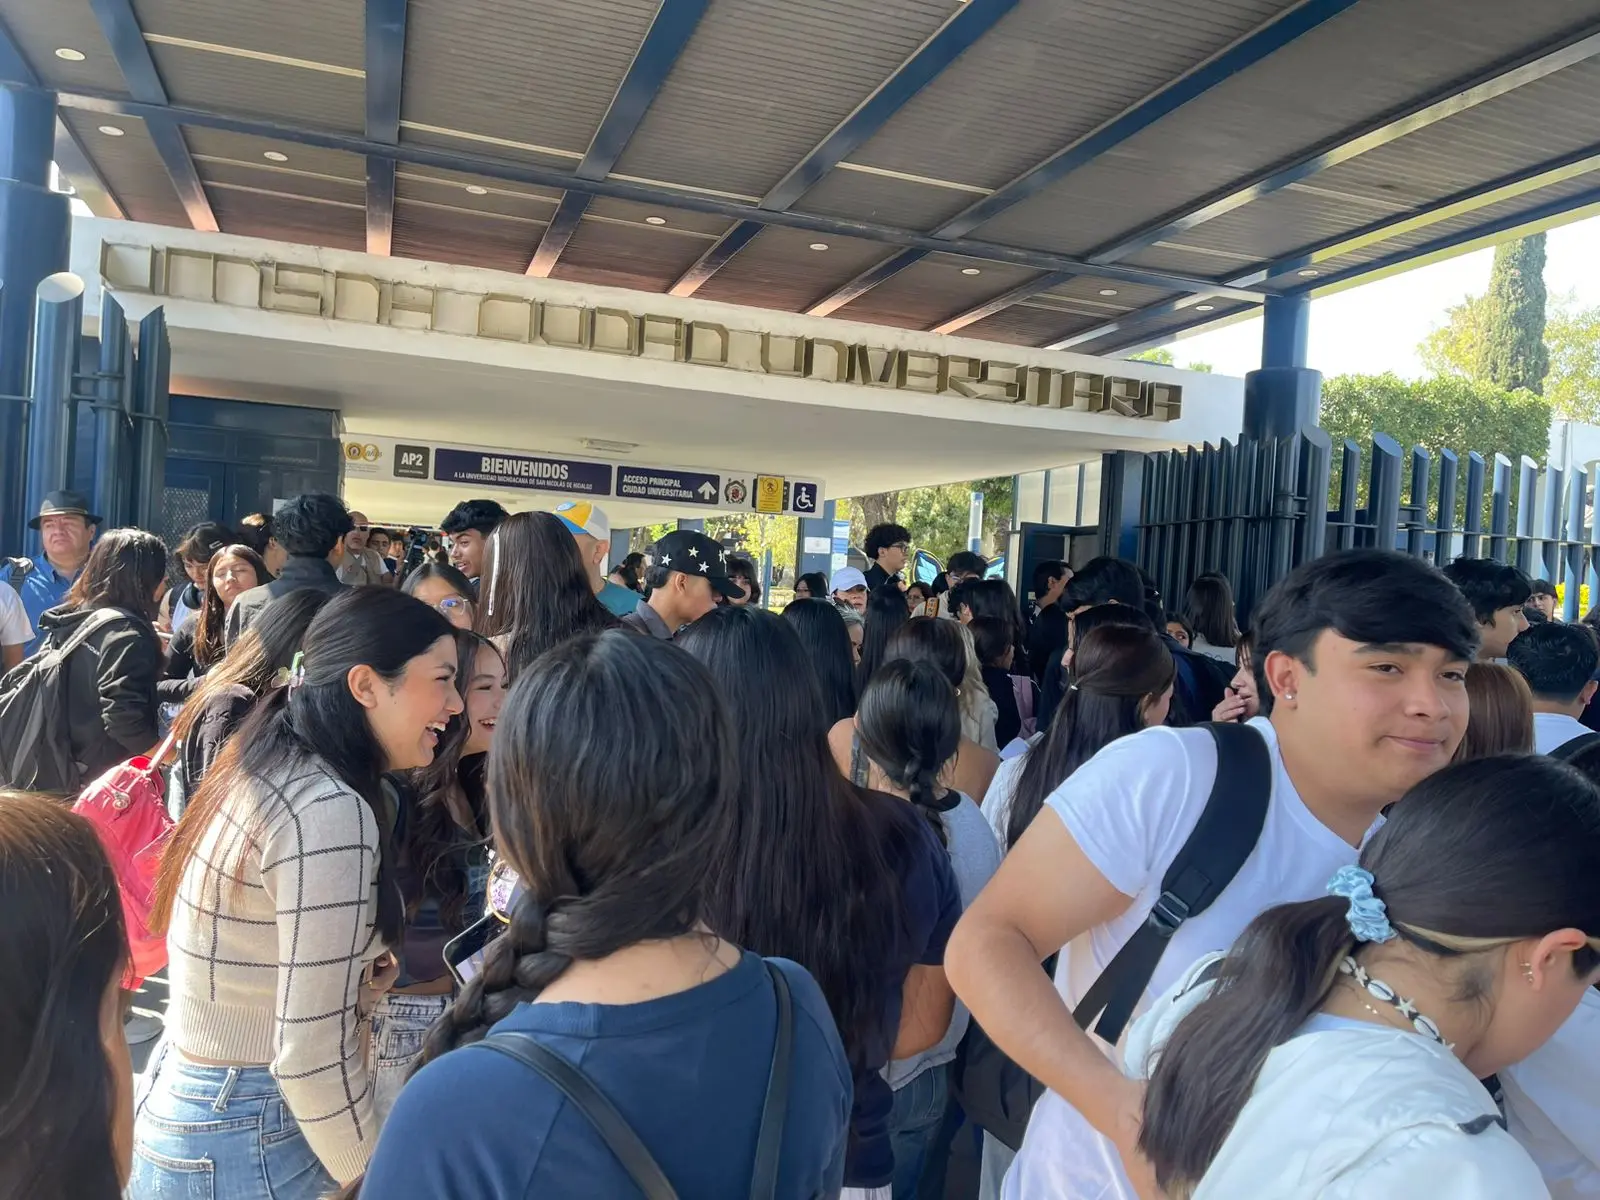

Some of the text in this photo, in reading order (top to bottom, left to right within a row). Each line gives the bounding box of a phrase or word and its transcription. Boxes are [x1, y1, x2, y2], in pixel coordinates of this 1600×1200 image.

[477, 292, 730, 365] CIUDAD
[760, 332, 1182, 422] UNIVERSITARIA
[401, 452, 423, 466] AP2
[481, 457, 569, 480] BIENVENIDOS
[466, 473, 496, 481] UNIVERSIDAD
[497, 475, 528, 484] MICHOACANA
[573, 482, 593, 490] HIDALGO
[623, 474, 682, 488] ACCESO PRINCIPAL
[622, 484, 694, 499] CIUDAD UNIVERSITARIA
